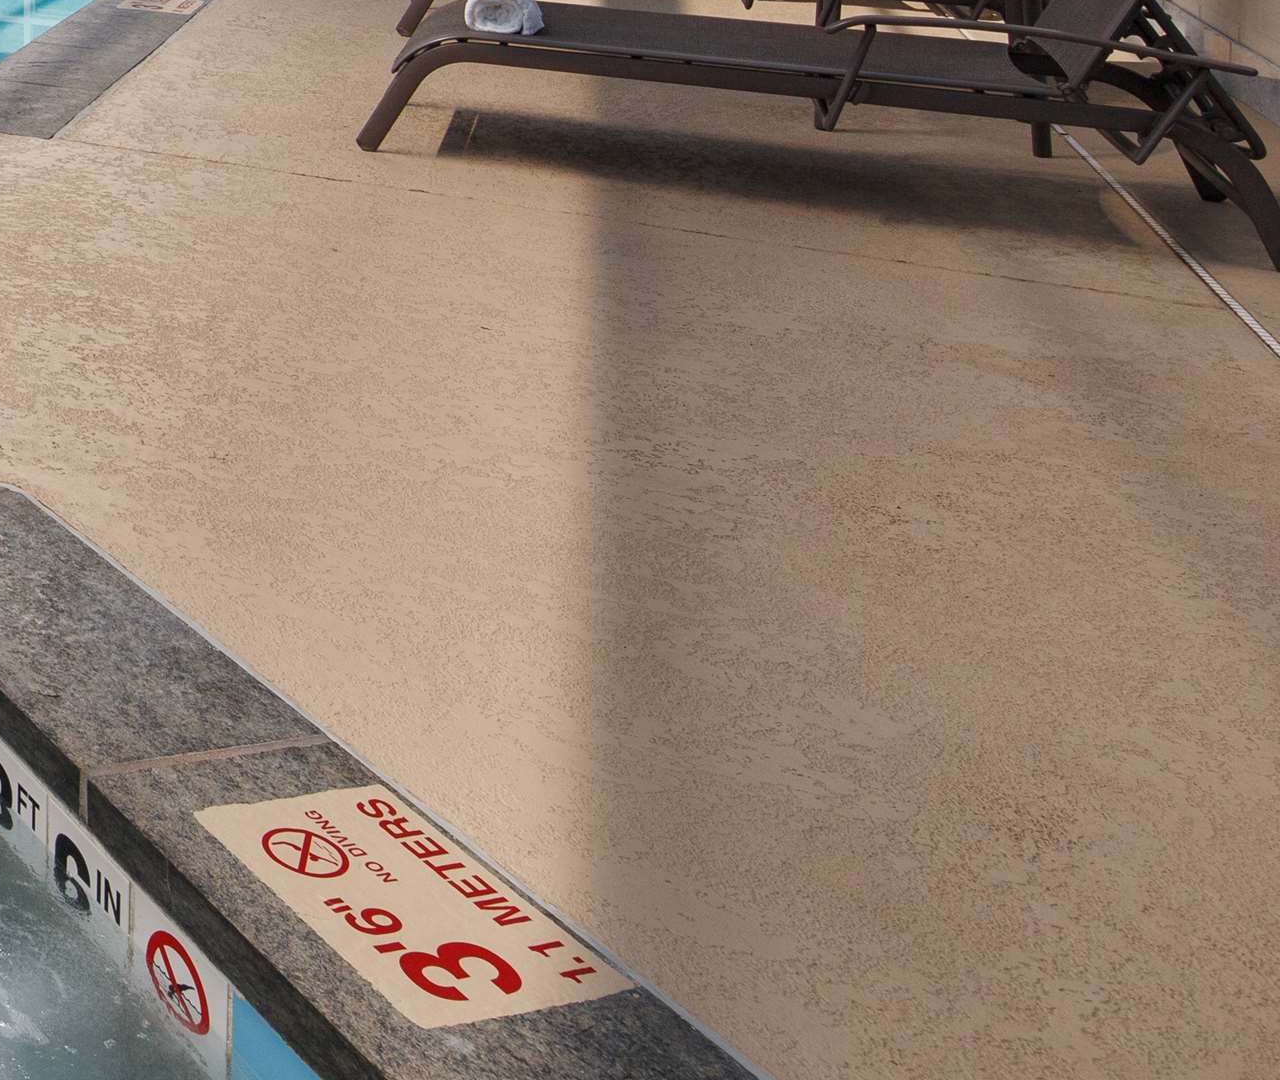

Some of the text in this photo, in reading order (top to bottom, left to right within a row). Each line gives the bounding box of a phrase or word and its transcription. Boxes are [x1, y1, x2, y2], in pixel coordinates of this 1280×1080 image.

[17, 783, 40, 831] FT
[54, 833, 91, 912] 6
[96, 869, 121, 926] IN
[304, 810, 398, 884] NO DIVING
[356, 798, 597, 984] 1.1 METERS
